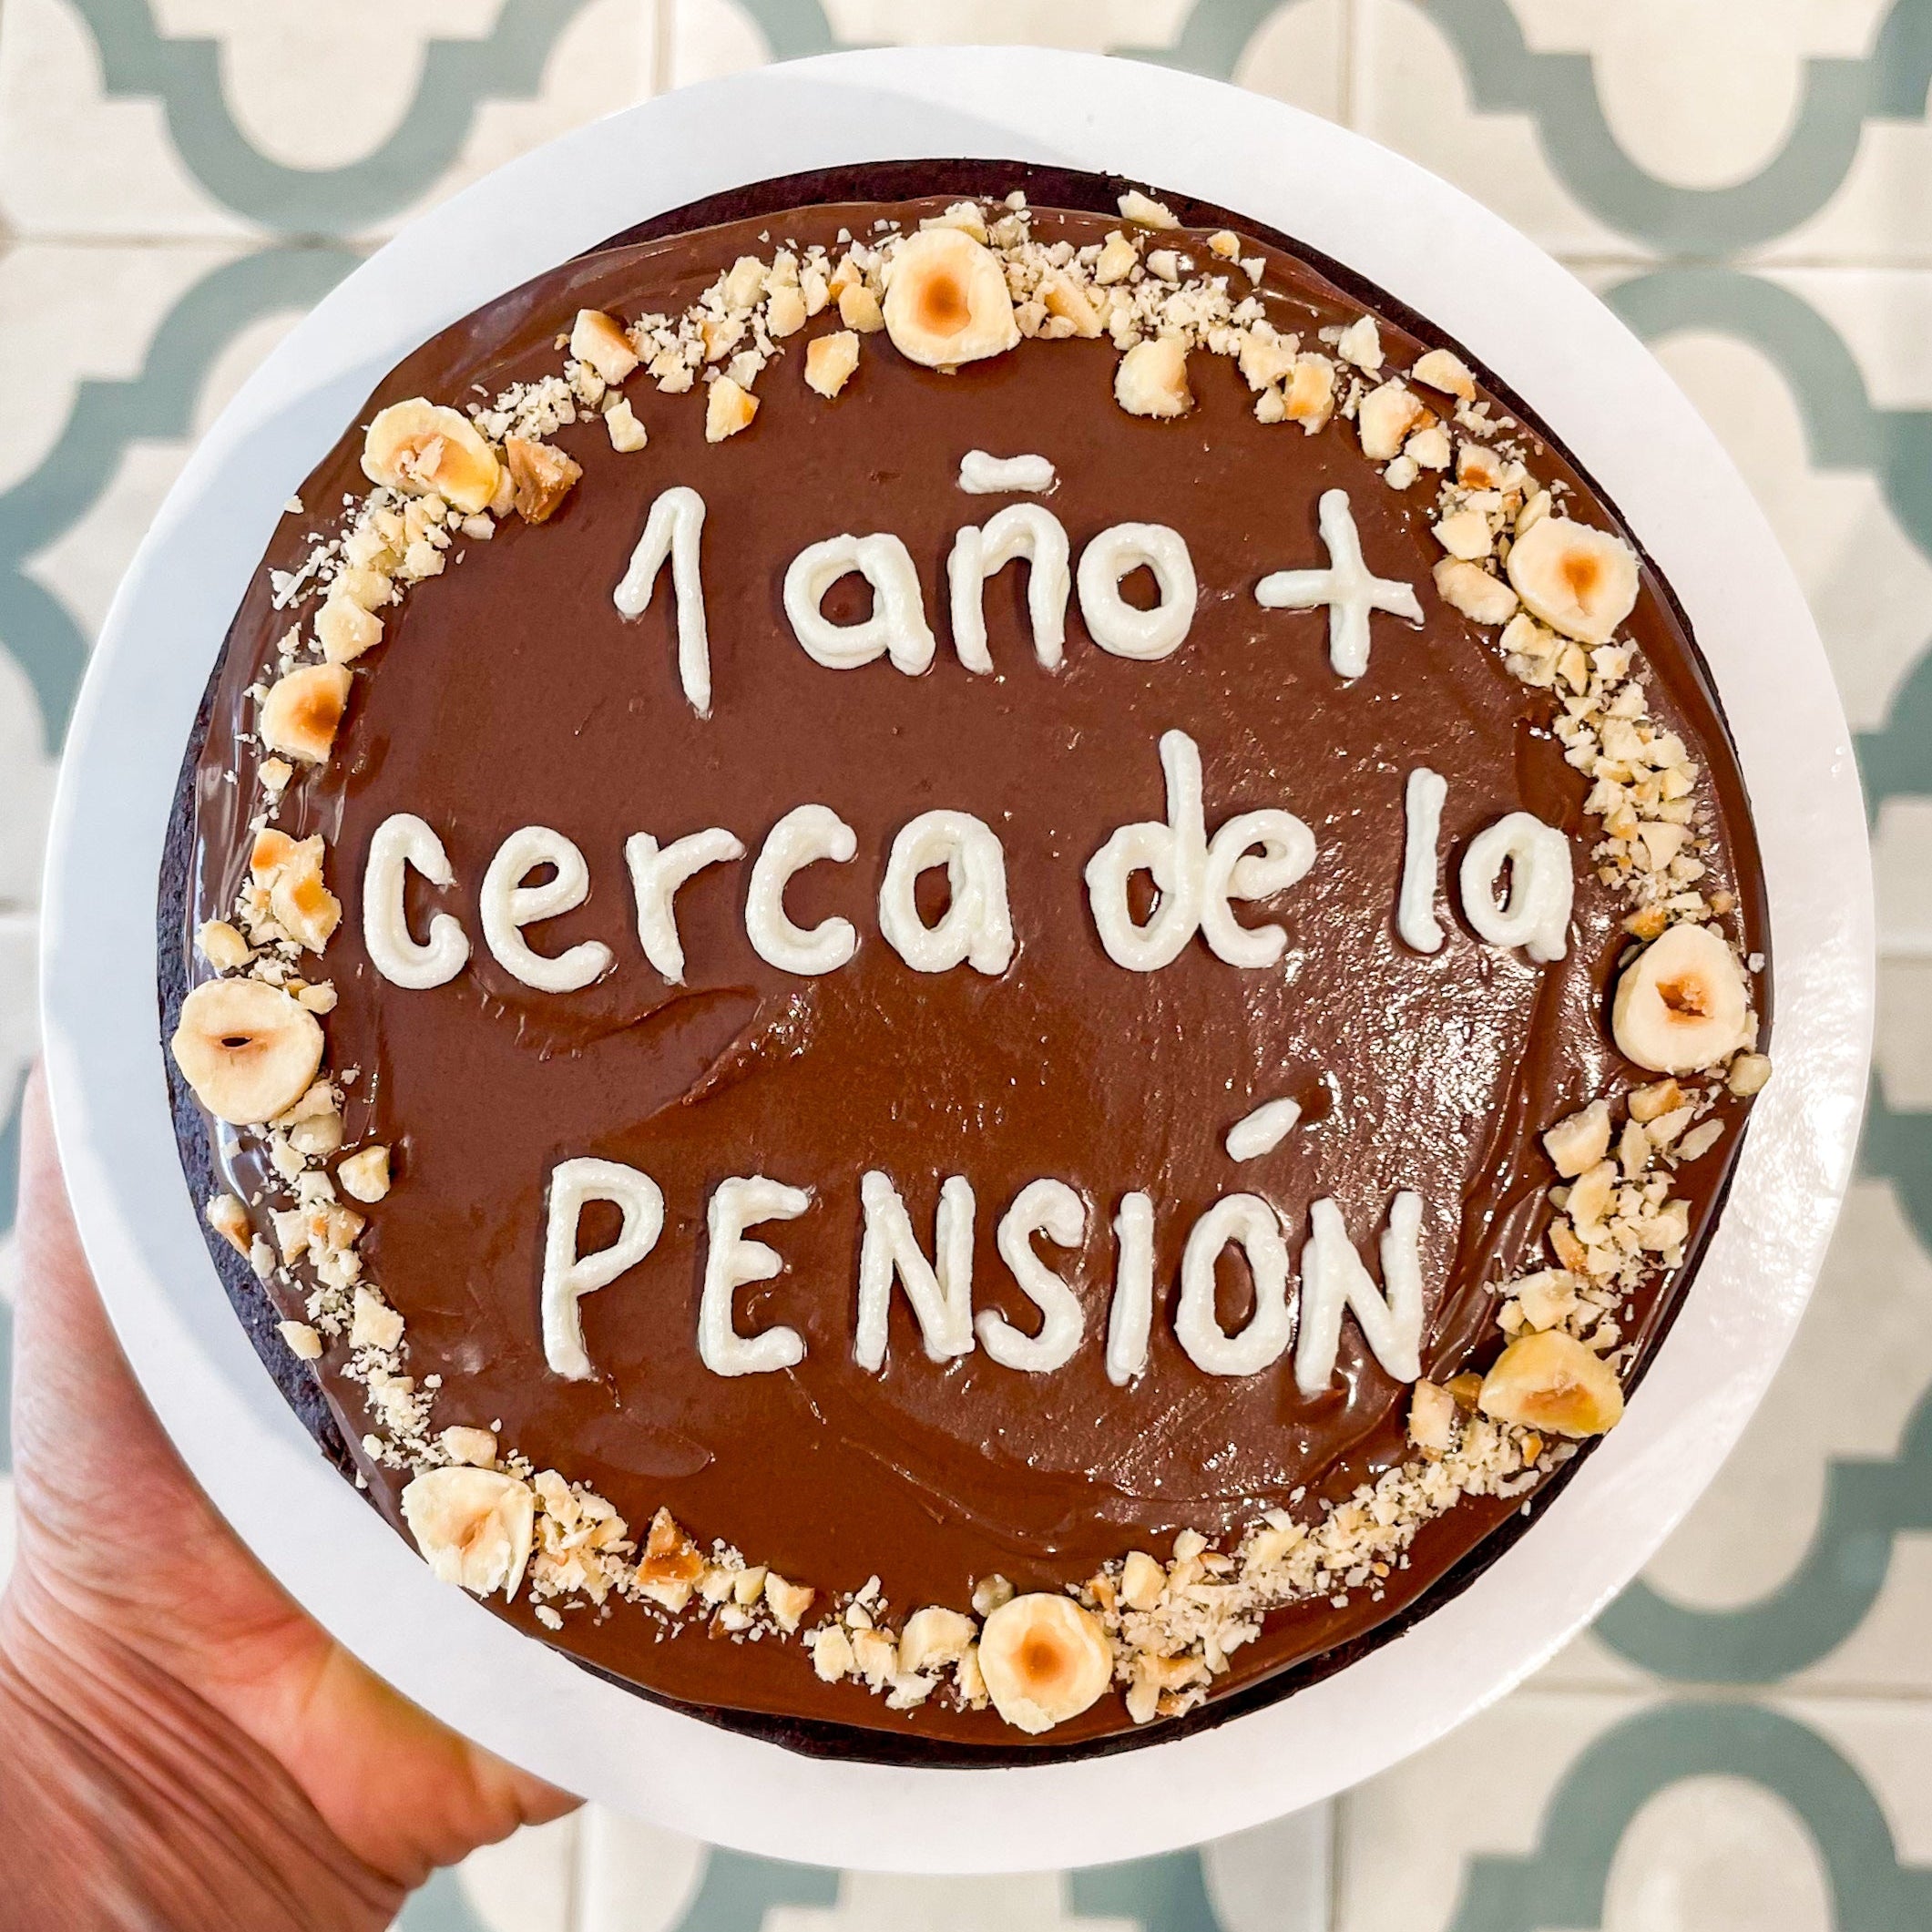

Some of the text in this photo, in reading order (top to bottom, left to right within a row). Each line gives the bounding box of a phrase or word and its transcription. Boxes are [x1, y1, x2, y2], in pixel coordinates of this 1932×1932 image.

[612, 449, 1425, 715] 1 año +
[362, 729, 1575, 991] cerca de la
[540, 1099, 1425, 1394] PENSIÓN
